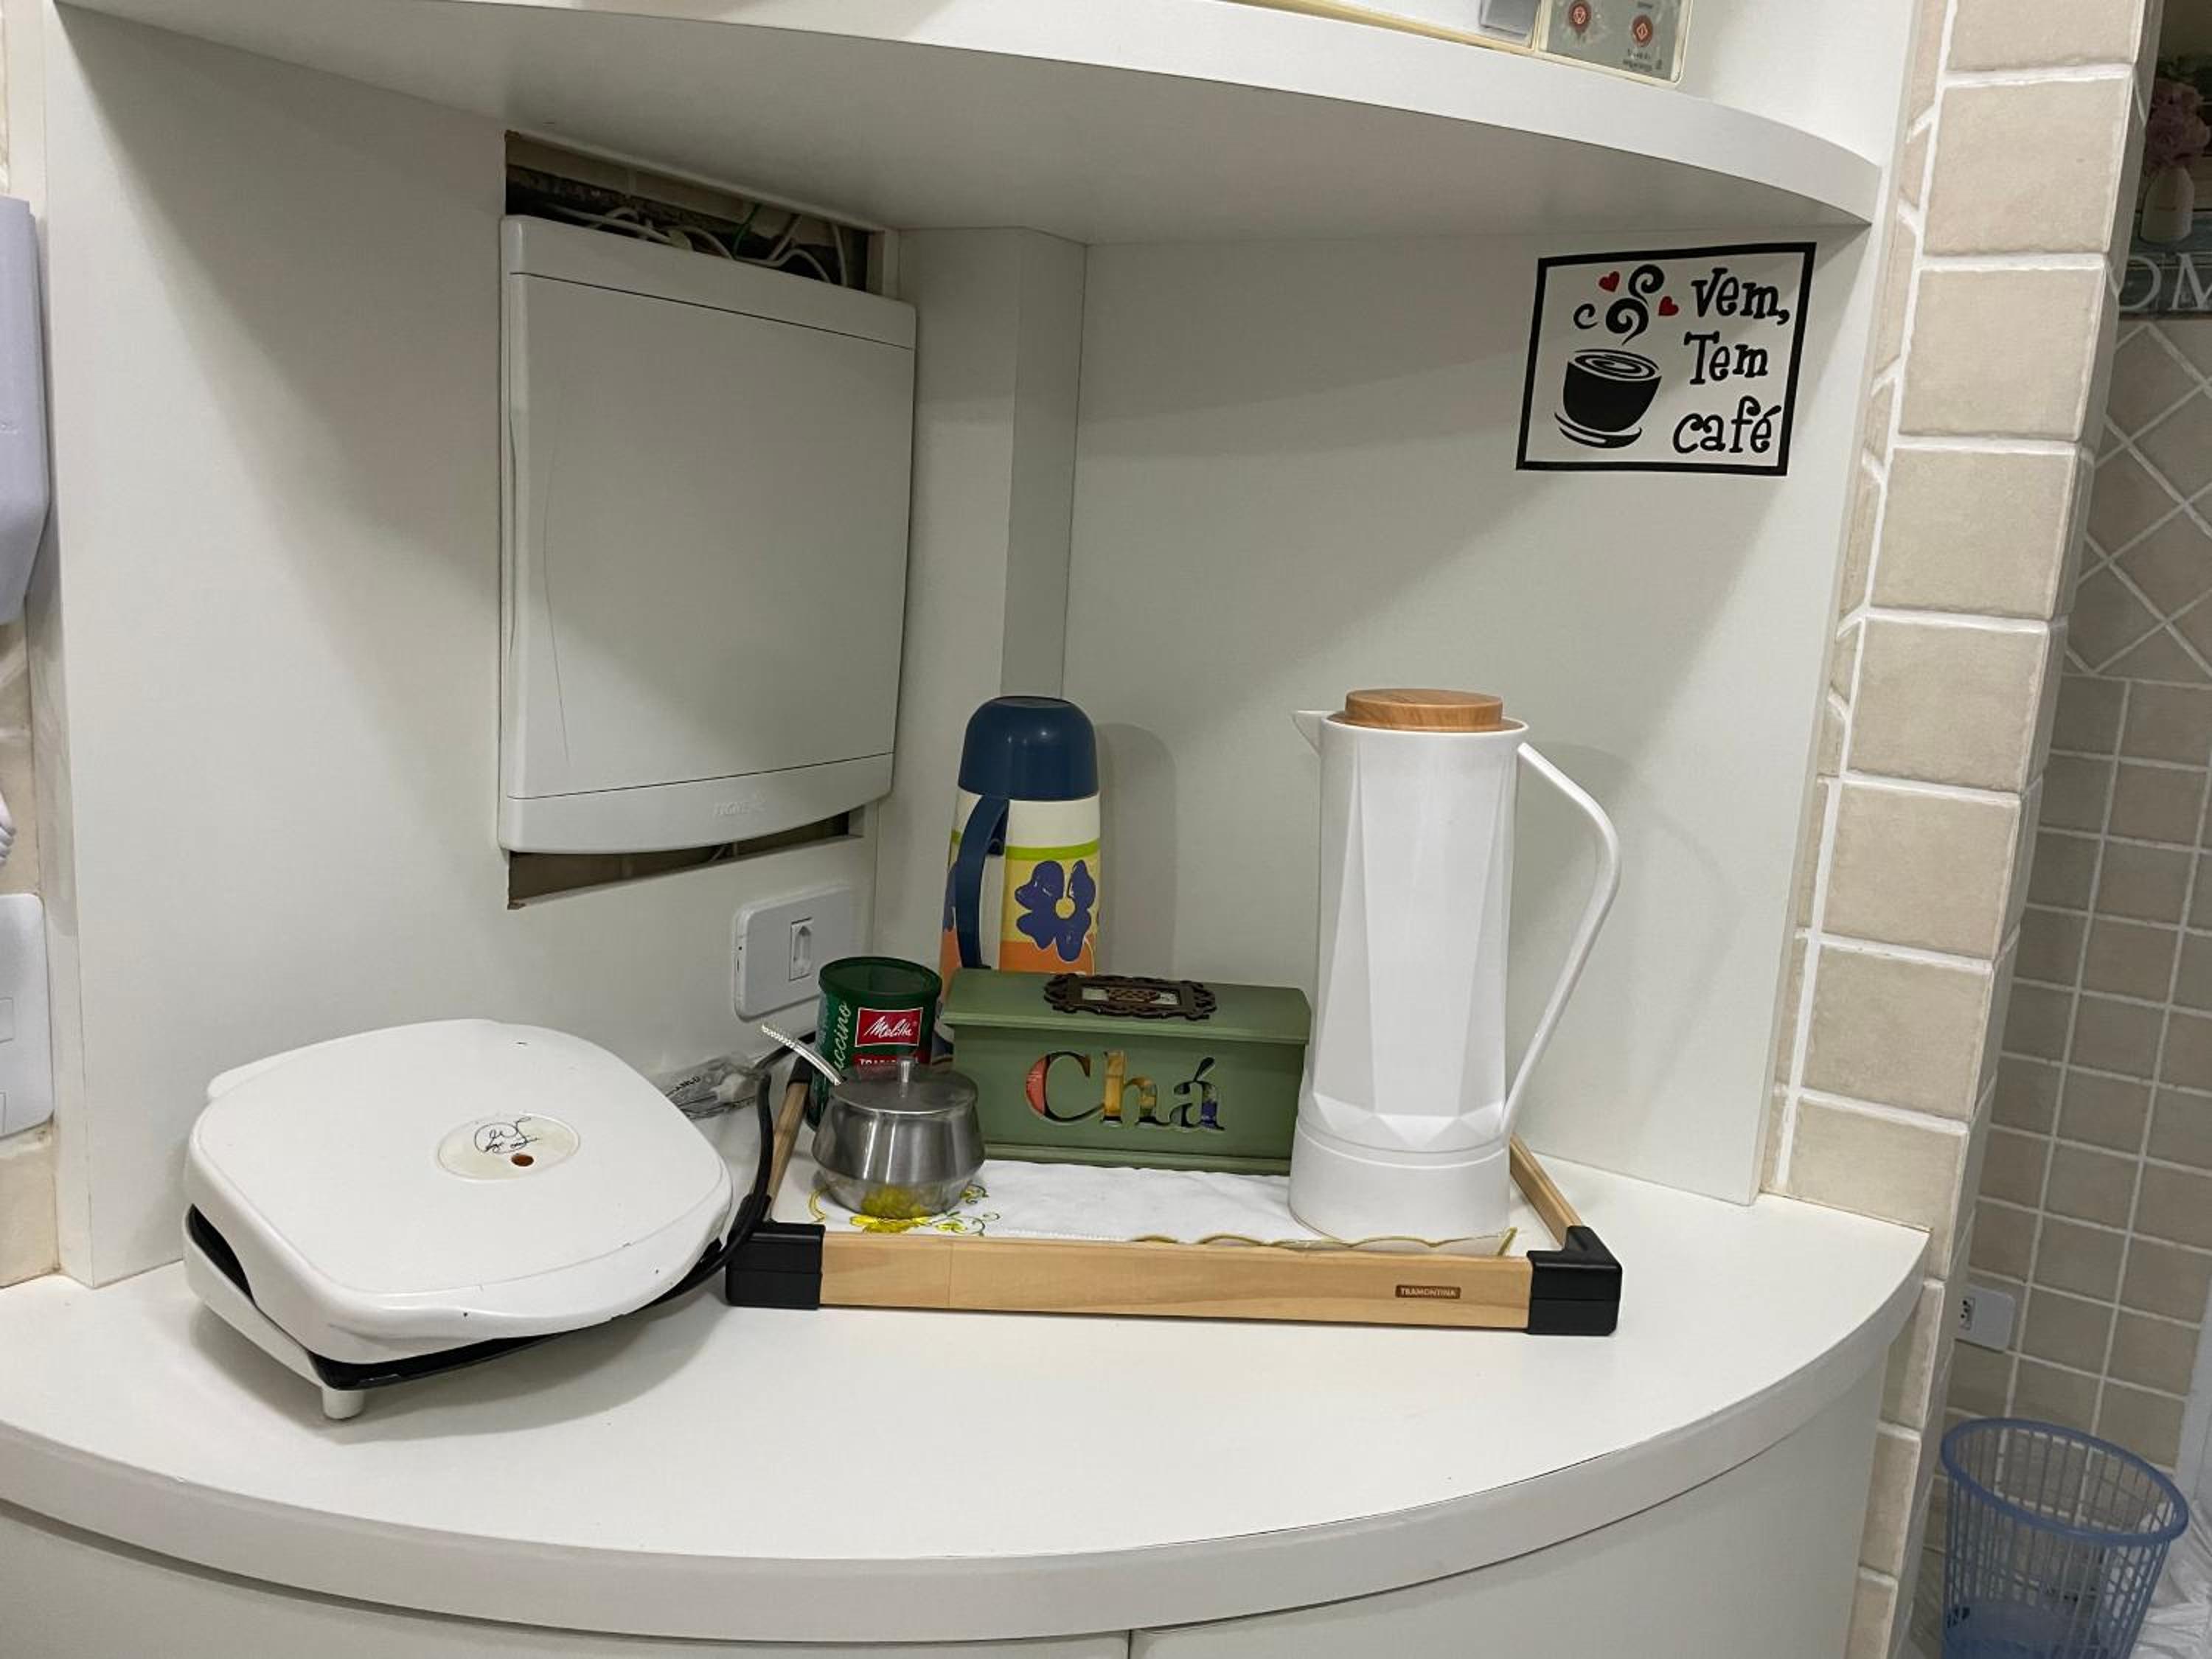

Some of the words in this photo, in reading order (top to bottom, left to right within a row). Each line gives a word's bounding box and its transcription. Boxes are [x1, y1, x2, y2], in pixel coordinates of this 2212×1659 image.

[1691, 267, 1790, 325] Vem,
[1683, 330, 1768, 385] Tem
[1672, 395, 1782, 454] café
[863, 1015, 913, 1039] Melitta
[1026, 1050, 1225, 1131] Chá
[1401, 1287, 1456, 1297] TRAMONTINA
